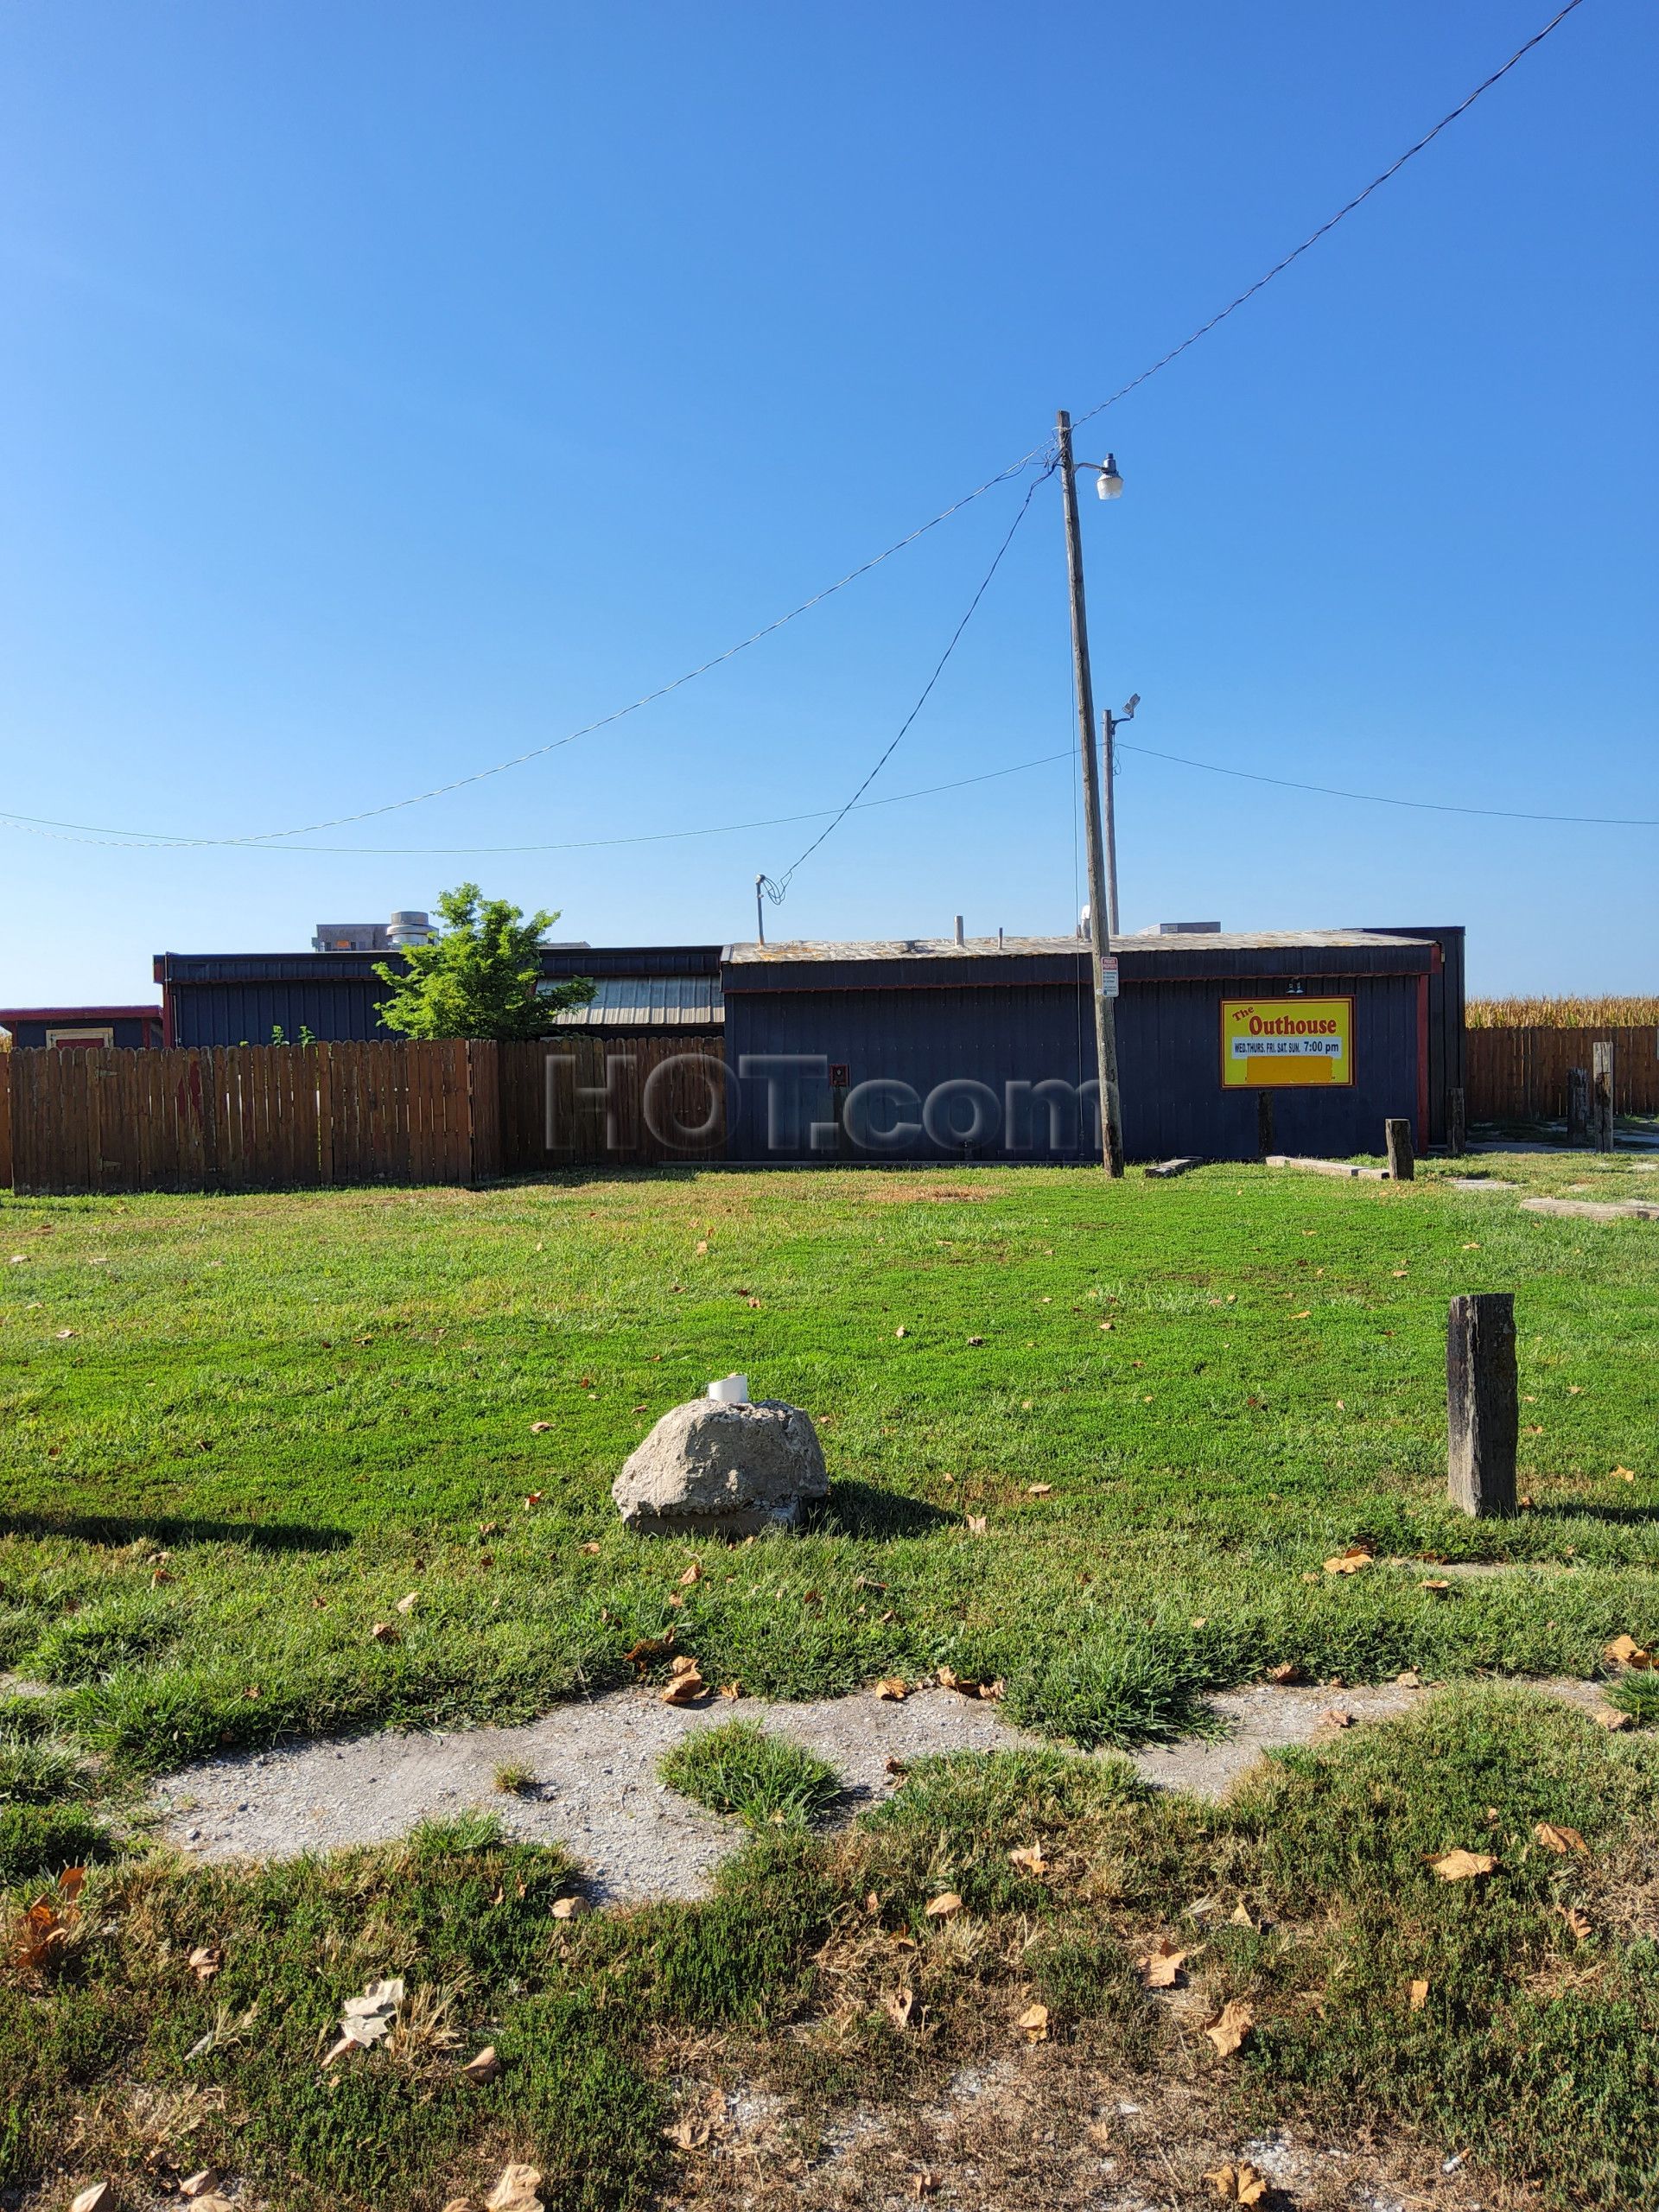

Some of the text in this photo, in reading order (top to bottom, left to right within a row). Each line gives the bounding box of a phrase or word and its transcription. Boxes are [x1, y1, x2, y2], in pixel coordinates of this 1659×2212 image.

[1232, 1006, 1255, 1021] The
[1249, 1015, 1337, 1035] Outhouse
[1304, 1041, 1323, 1052] 7:00
[1325, 1042, 1339, 1054] pm
